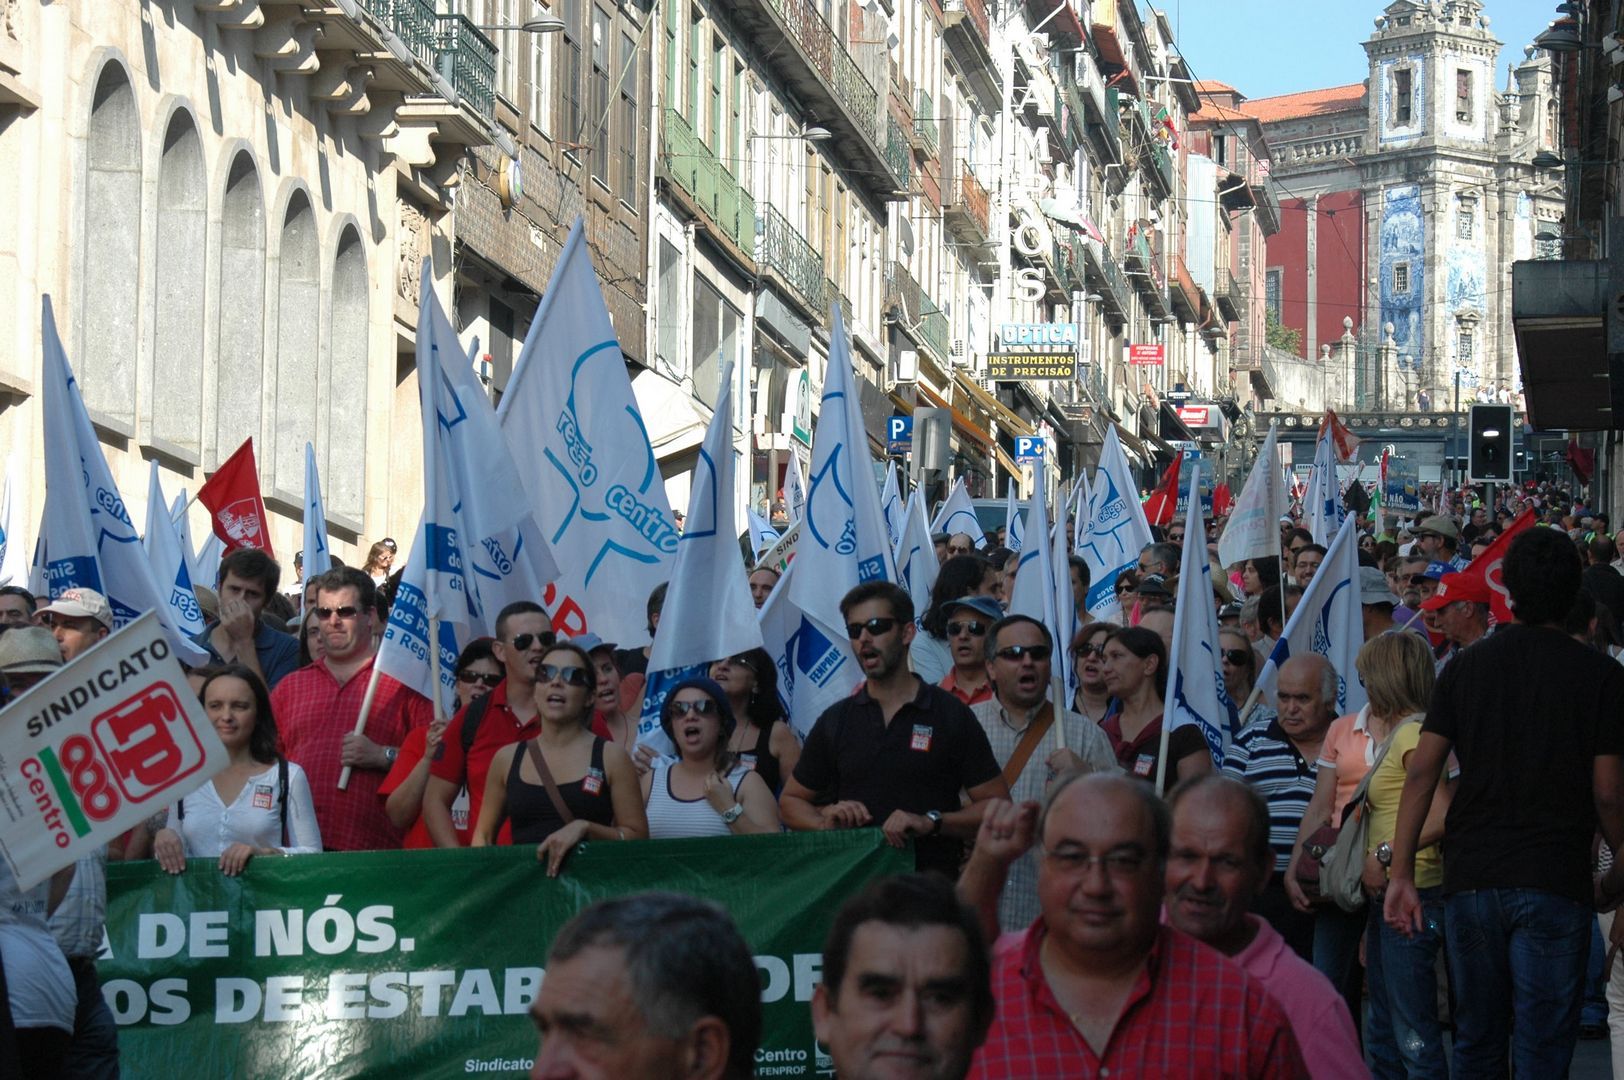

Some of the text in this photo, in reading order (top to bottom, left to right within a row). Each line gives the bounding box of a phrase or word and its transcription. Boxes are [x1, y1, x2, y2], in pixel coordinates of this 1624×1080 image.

[988, 356, 1075, 365] INSTRUMENTOS
[991, 365, 1072, 376] DE PRECISÃO
[891, 419, 905, 440] P
[1018, 438, 1032, 456] P
[1183, 451, 1192, 460] P
[605, 484, 679, 553] centro
[809, 647, 842, 684] FENPROF
[26, 638, 170, 739] SINDICATO
[20, 757, 71, 849] Centro
[138, 910, 229, 959] DE
[254, 894, 415, 956] NÓS.
[215, 975, 302, 1023] DE
[754, 1047, 808, 1063] Centro
[464, 1058, 535, 1074] Sindicato
[760, 1065, 807, 1077] FENPROF
